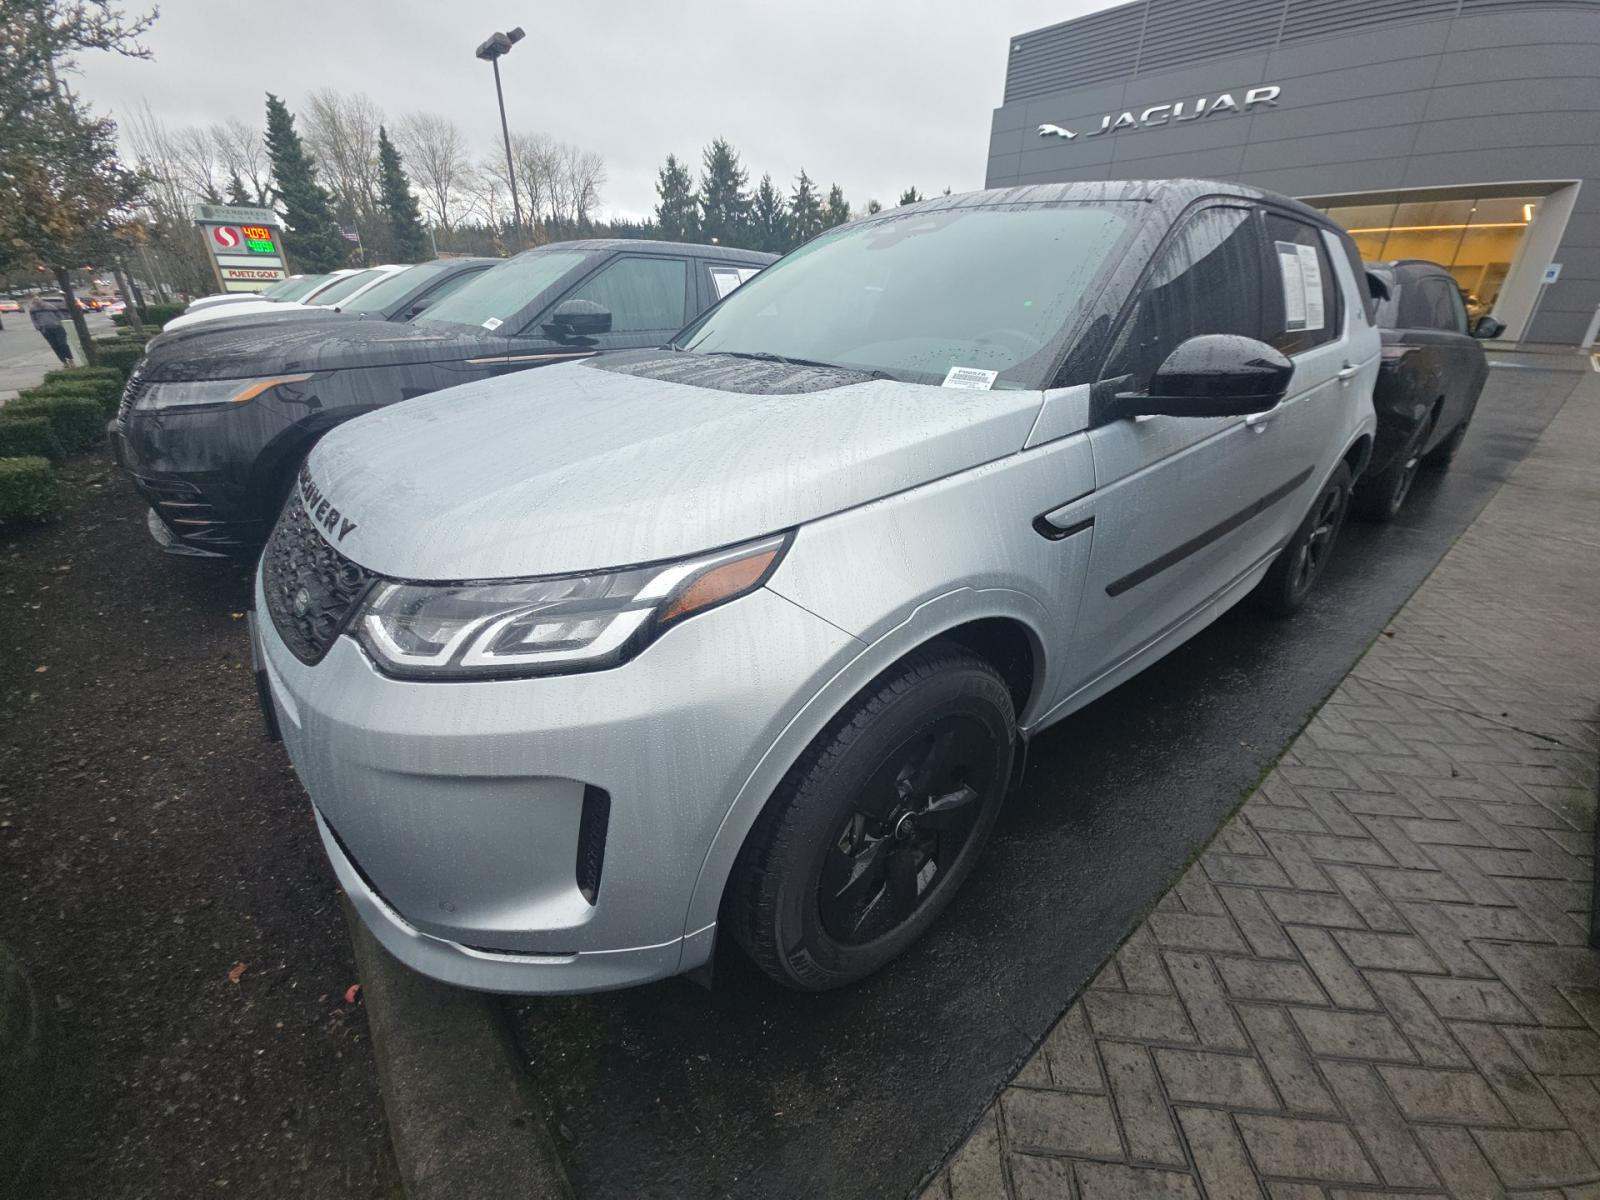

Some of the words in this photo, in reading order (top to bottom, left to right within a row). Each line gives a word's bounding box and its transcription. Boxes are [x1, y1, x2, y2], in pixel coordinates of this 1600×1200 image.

[1086, 85, 1281, 136] JAGUAR
[229, 270, 256, 279] PUETZ
[256, 271, 279, 279] GOLF
